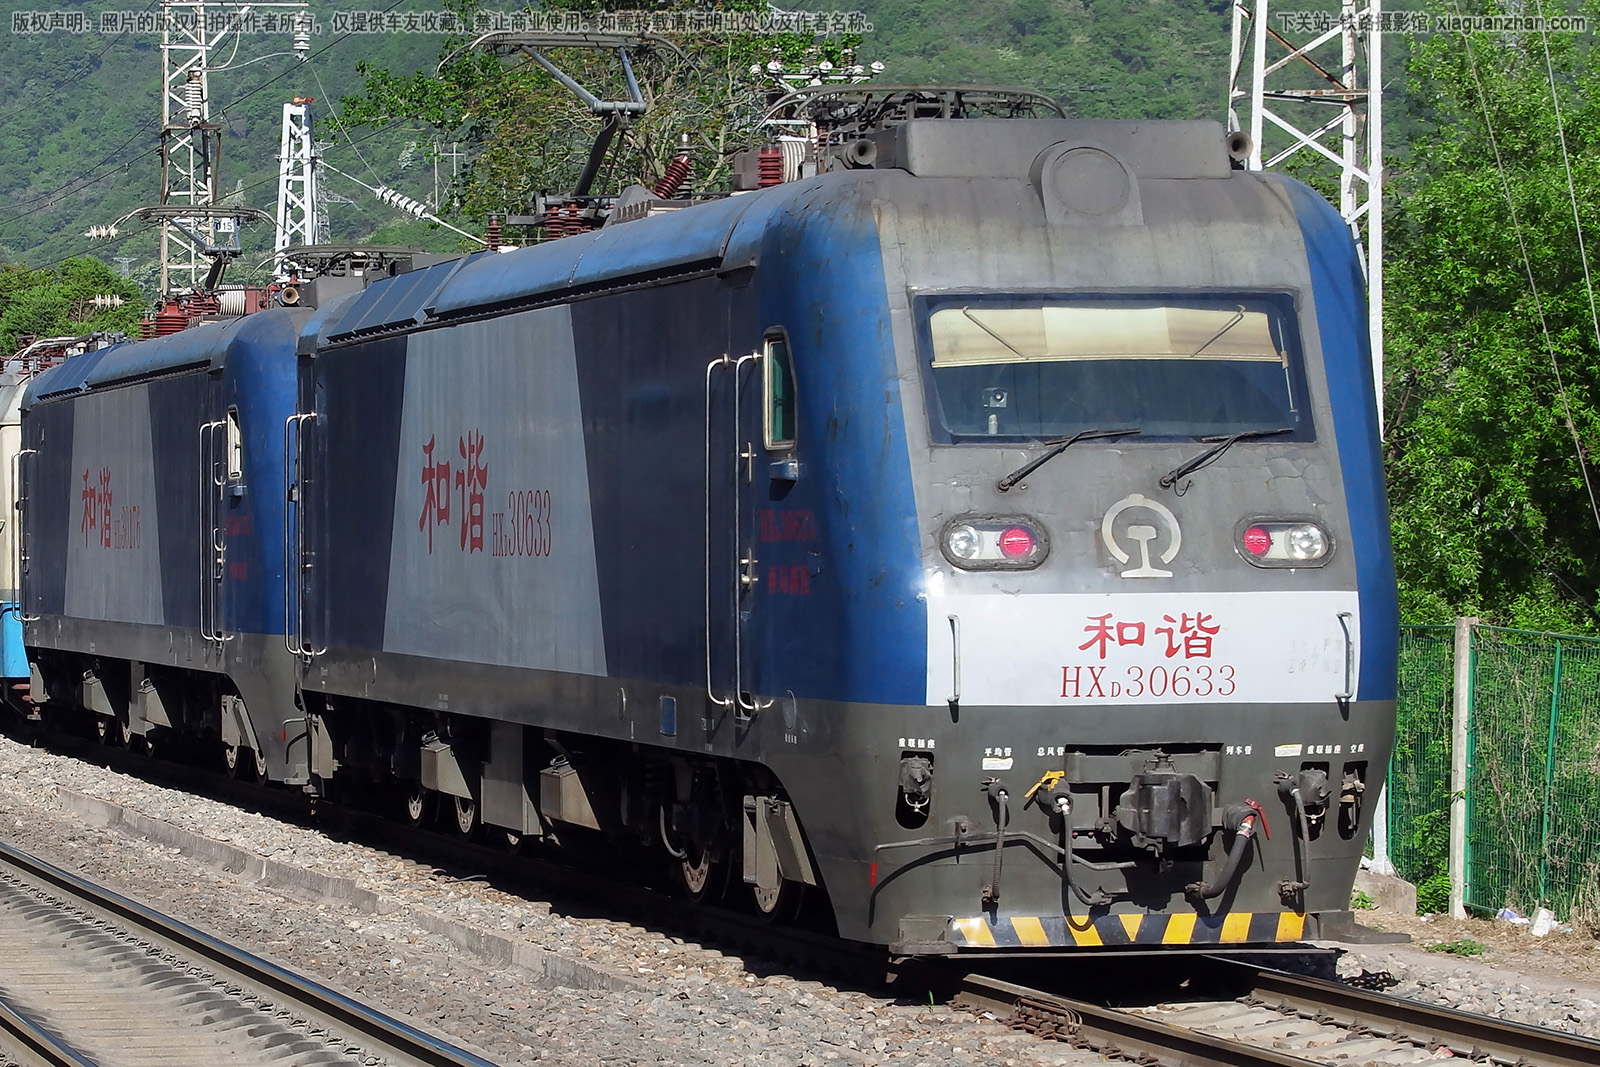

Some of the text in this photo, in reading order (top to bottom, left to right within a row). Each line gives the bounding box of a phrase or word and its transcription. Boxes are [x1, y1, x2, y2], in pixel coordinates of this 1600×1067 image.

[81, 466, 113, 549] 和谐
[419, 428, 488, 555] 和谐
[1078, 611, 1222, 660] 和谐
[1060, 665, 1237, 698] HXD30633
